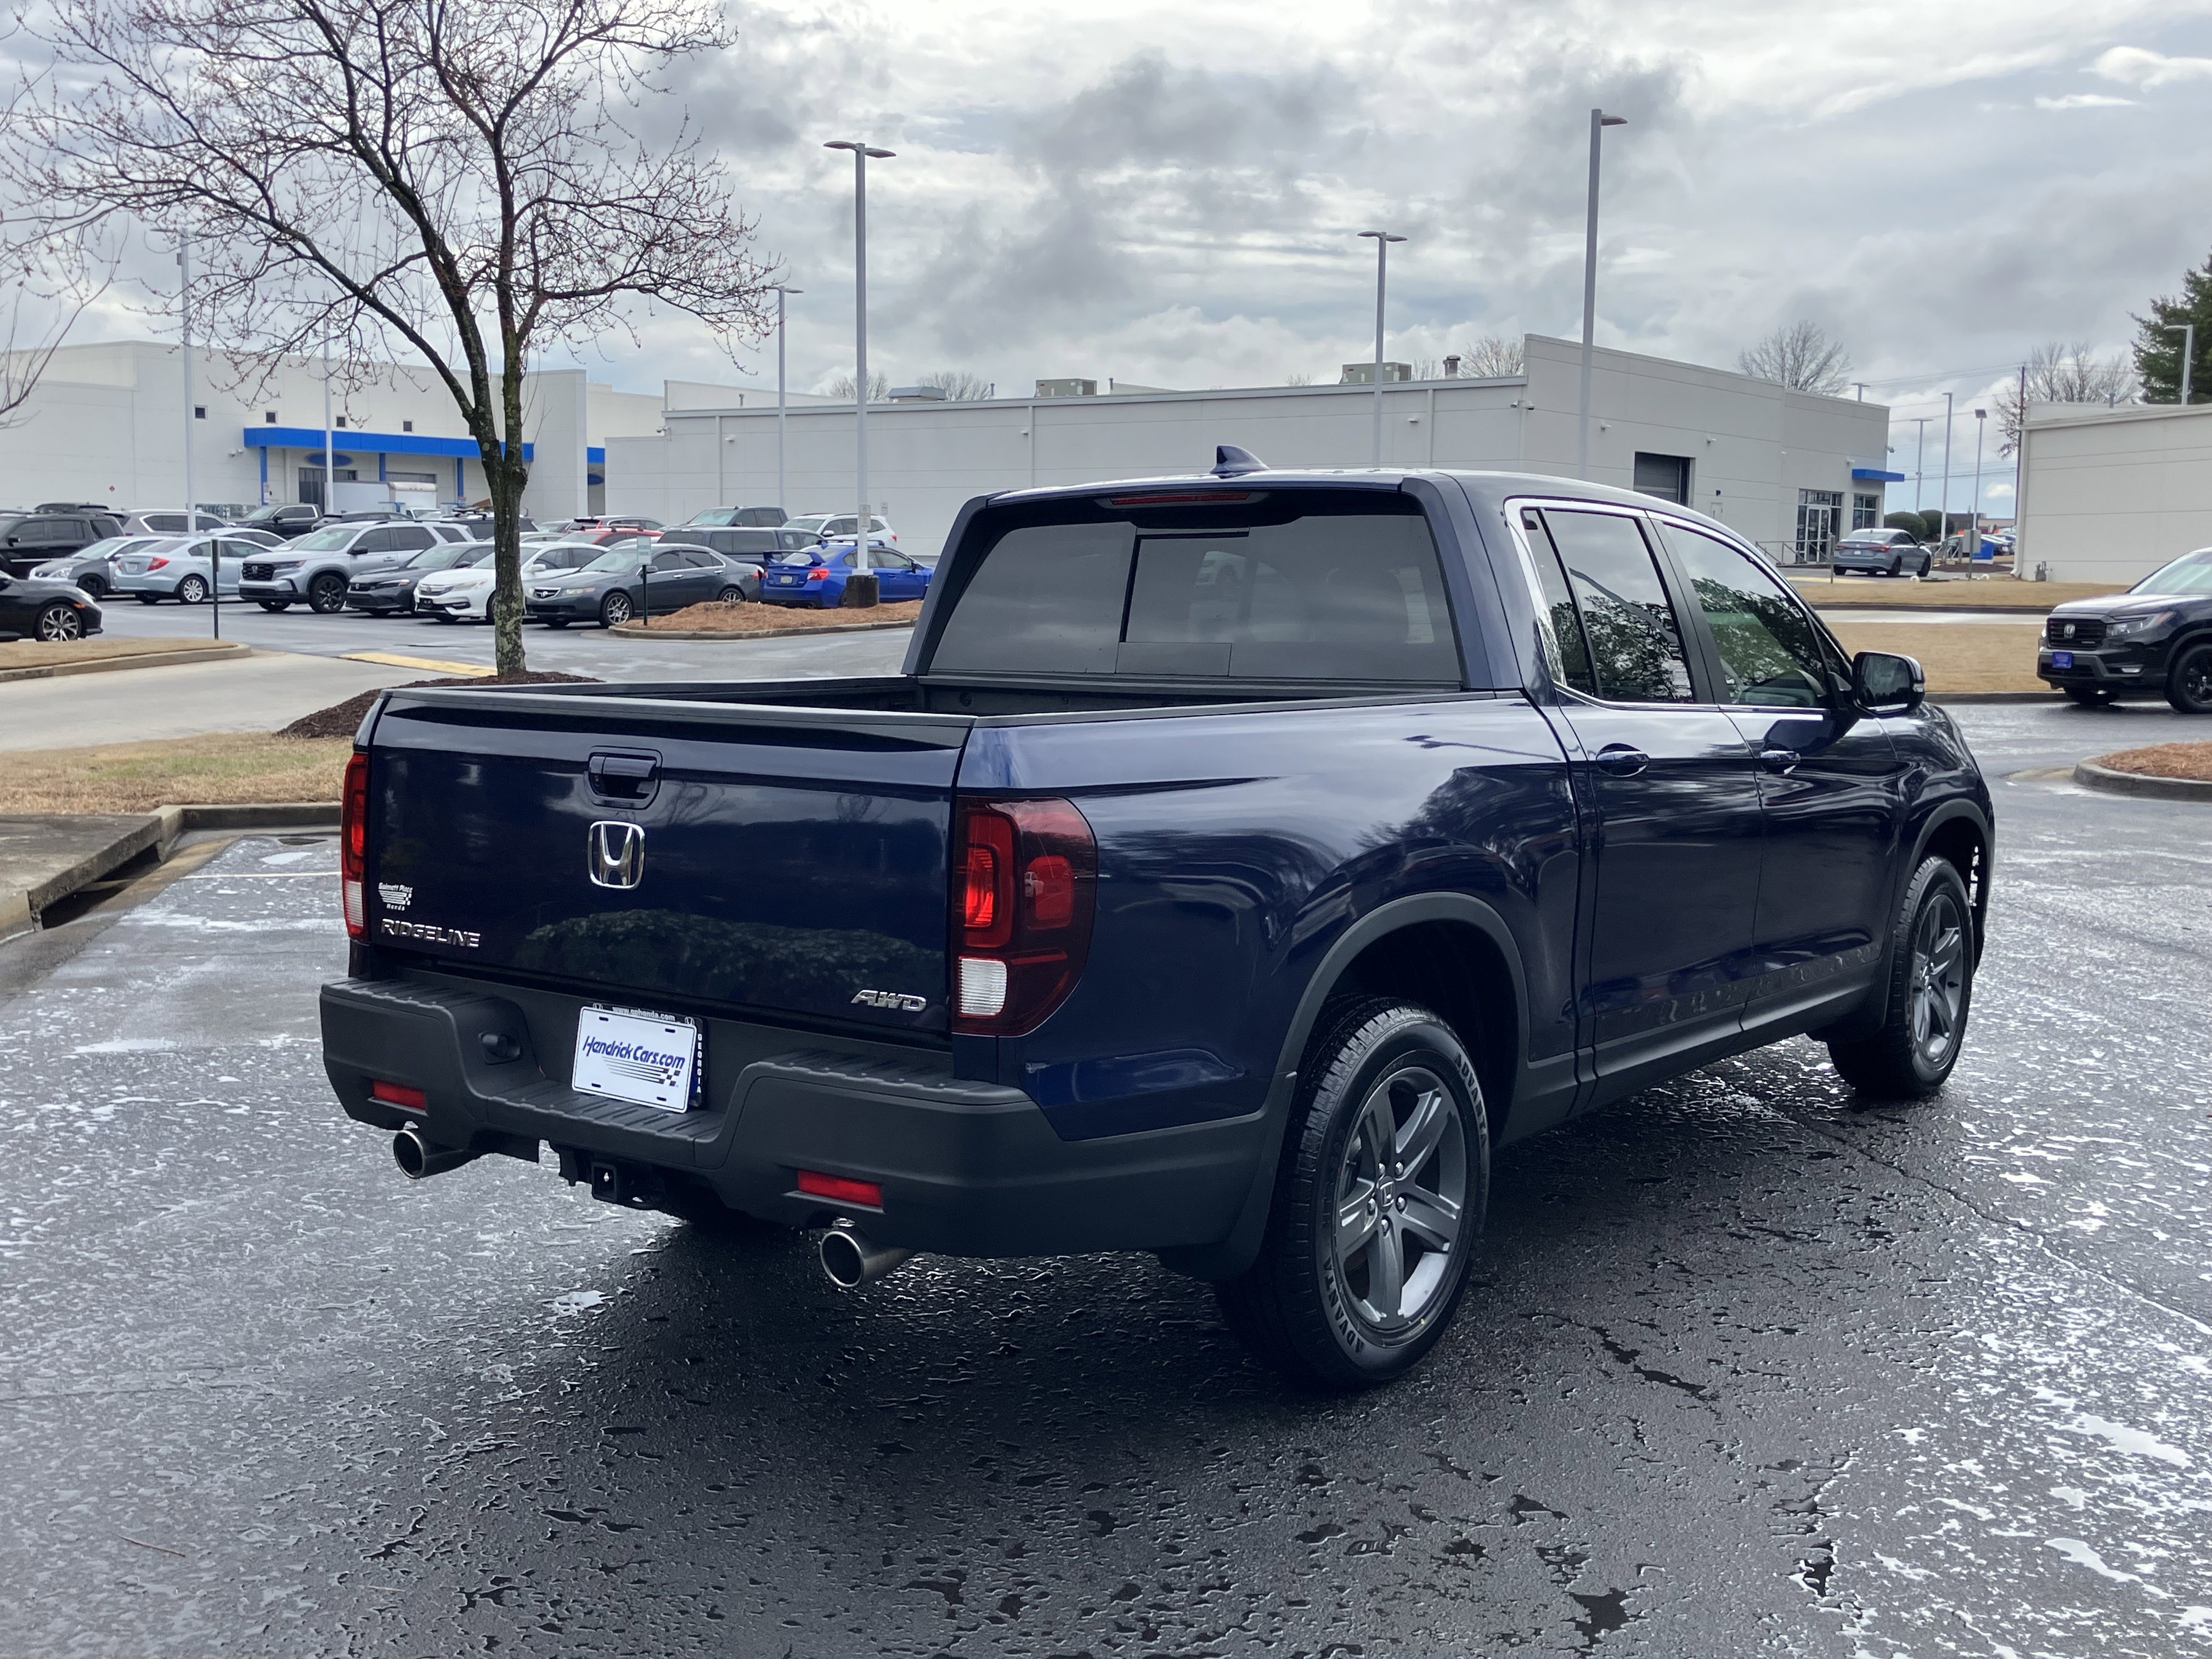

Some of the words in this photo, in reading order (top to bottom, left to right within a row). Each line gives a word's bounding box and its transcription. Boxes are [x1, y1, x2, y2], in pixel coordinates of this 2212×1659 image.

[381, 918, 481, 947] RIDGELINE
[851, 989, 927, 1012] AWD
[1454, 1051, 1487, 1148] ADVANTA
[1323, 1255, 1365, 1353] ADVANTA
